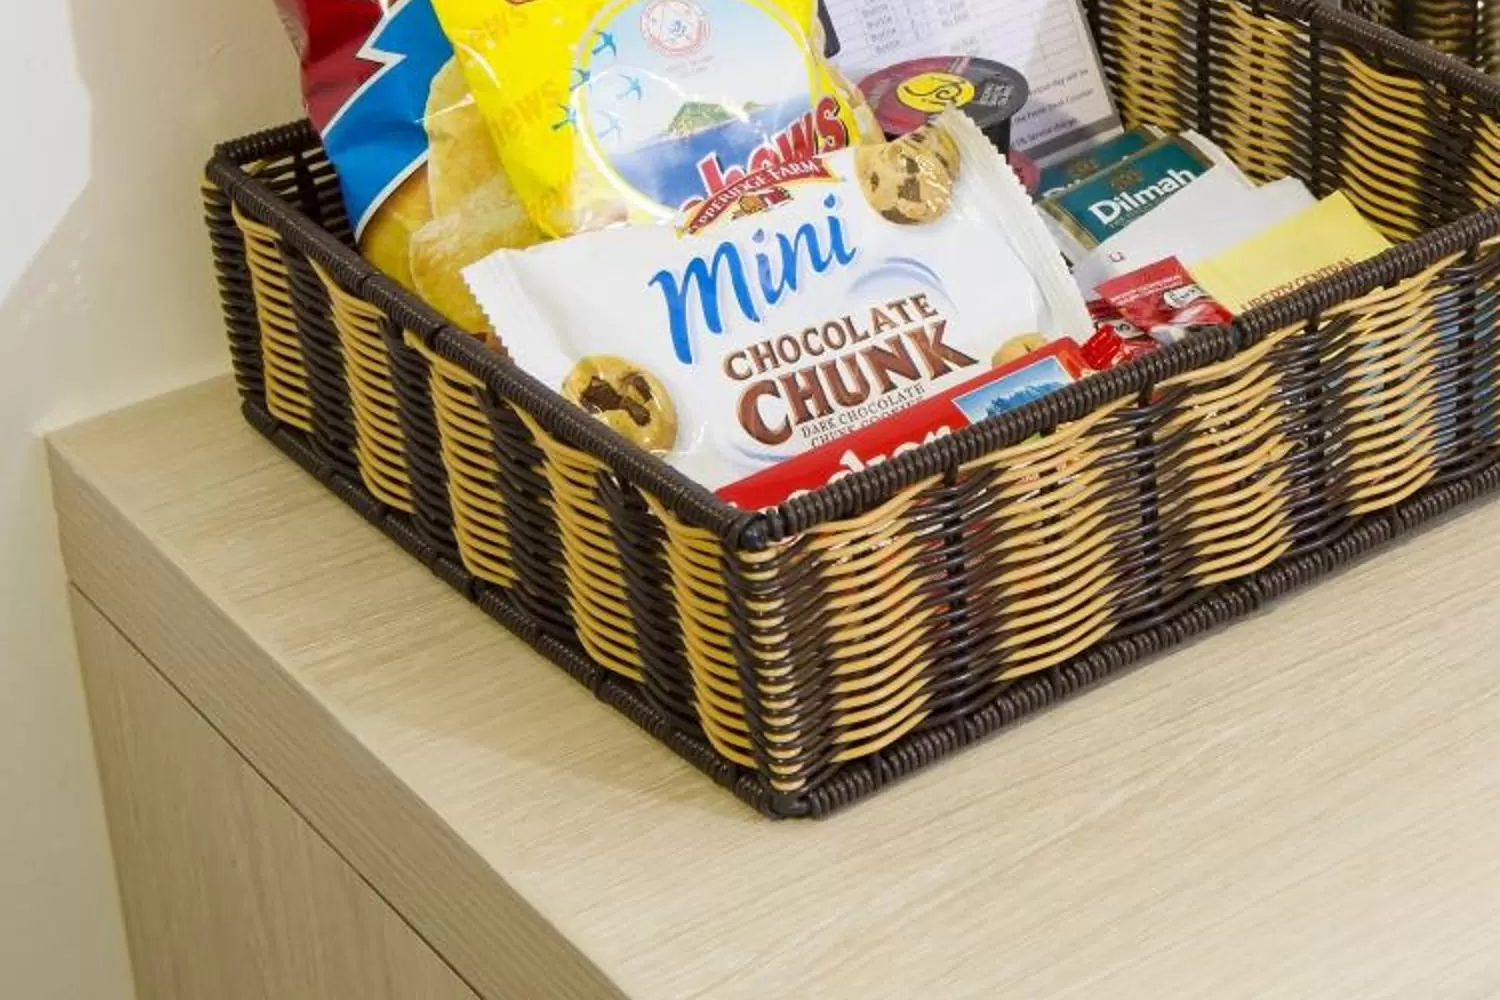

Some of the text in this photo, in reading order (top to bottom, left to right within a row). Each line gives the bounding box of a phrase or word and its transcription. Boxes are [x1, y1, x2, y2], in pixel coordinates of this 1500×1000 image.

[769, 158, 820, 182] FARM
[1088, 168, 1198, 225] Dilmah
[649, 192, 858, 367] Mini
[723, 291, 941, 383] CHOCOLATE
[736, 319, 978, 446] CHUNK
[801, 382, 926, 440] DARK CHOCOLATE
